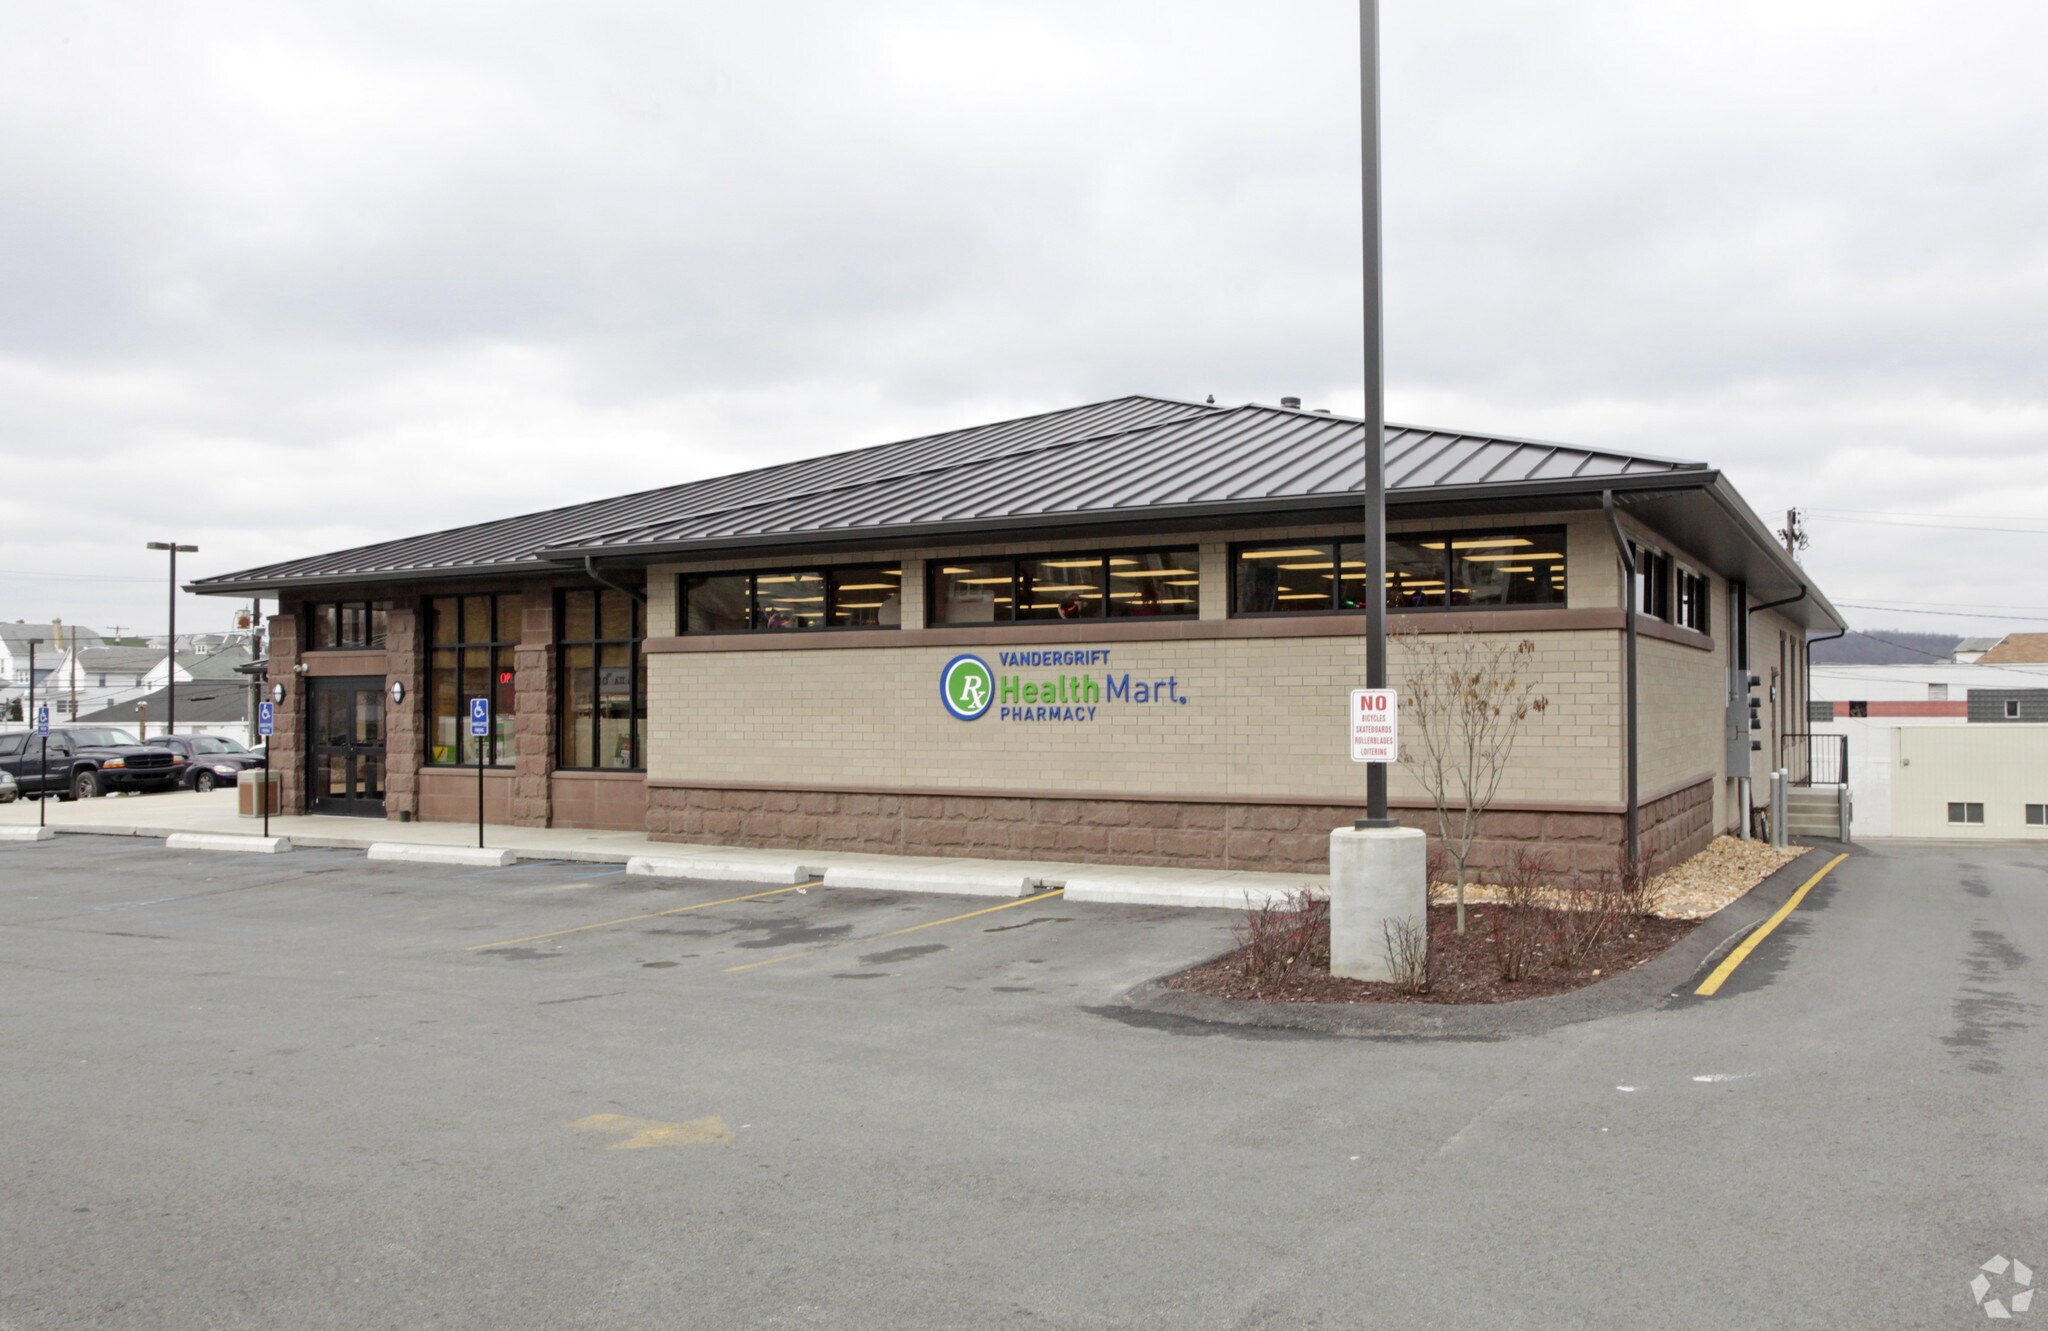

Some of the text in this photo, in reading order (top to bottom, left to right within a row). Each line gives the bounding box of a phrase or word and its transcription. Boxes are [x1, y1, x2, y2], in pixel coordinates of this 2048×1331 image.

[999, 650, 1110, 667] VANDERGRIFT
[1000, 674, 1100, 704] Health
[1361, 695, 1387, 711] NO
[1001, 706, 1096, 722] PHARMACY
[1361, 714, 1386, 722] BICYCLES
[1356, 725, 1392, 734] SKATEBOARDS
[1354, 736, 1393, 745] ROLLERBLADES
[1360, 748, 1387, 756] LOITERING
